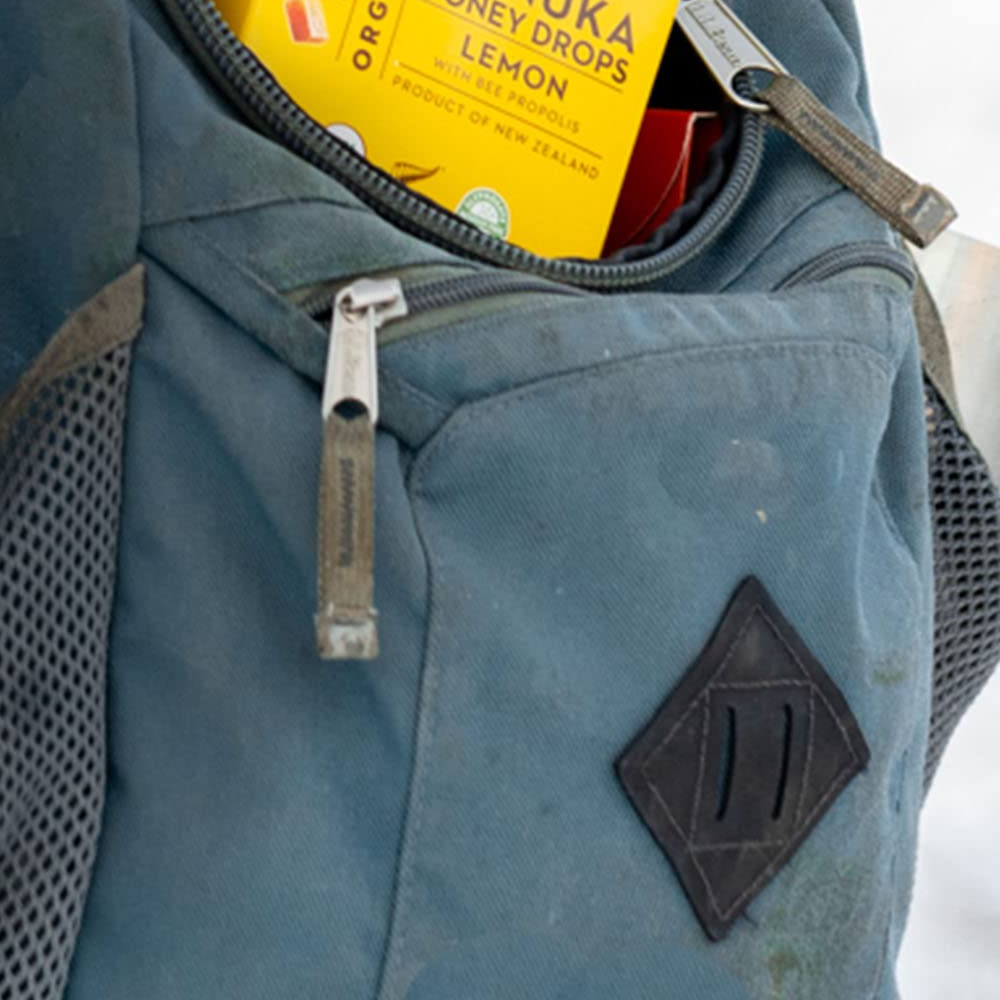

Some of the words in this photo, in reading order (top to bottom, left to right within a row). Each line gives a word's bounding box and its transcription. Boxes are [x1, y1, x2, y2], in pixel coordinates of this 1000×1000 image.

[461, 34, 569, 101] LEMON
[531, 21, 629, 85] DROPS
[392, 75, 465, 117] PRODUCT
[469, 110, 490, 128] OF
[495, 121, 528, 147] NEW
[532, 139, 600, 180] ZEALAND
[433, 56, 472, 83] WITH
[476, 72, 502, 98] BEE
[507, 90, 580, 134] PROPOLIS
